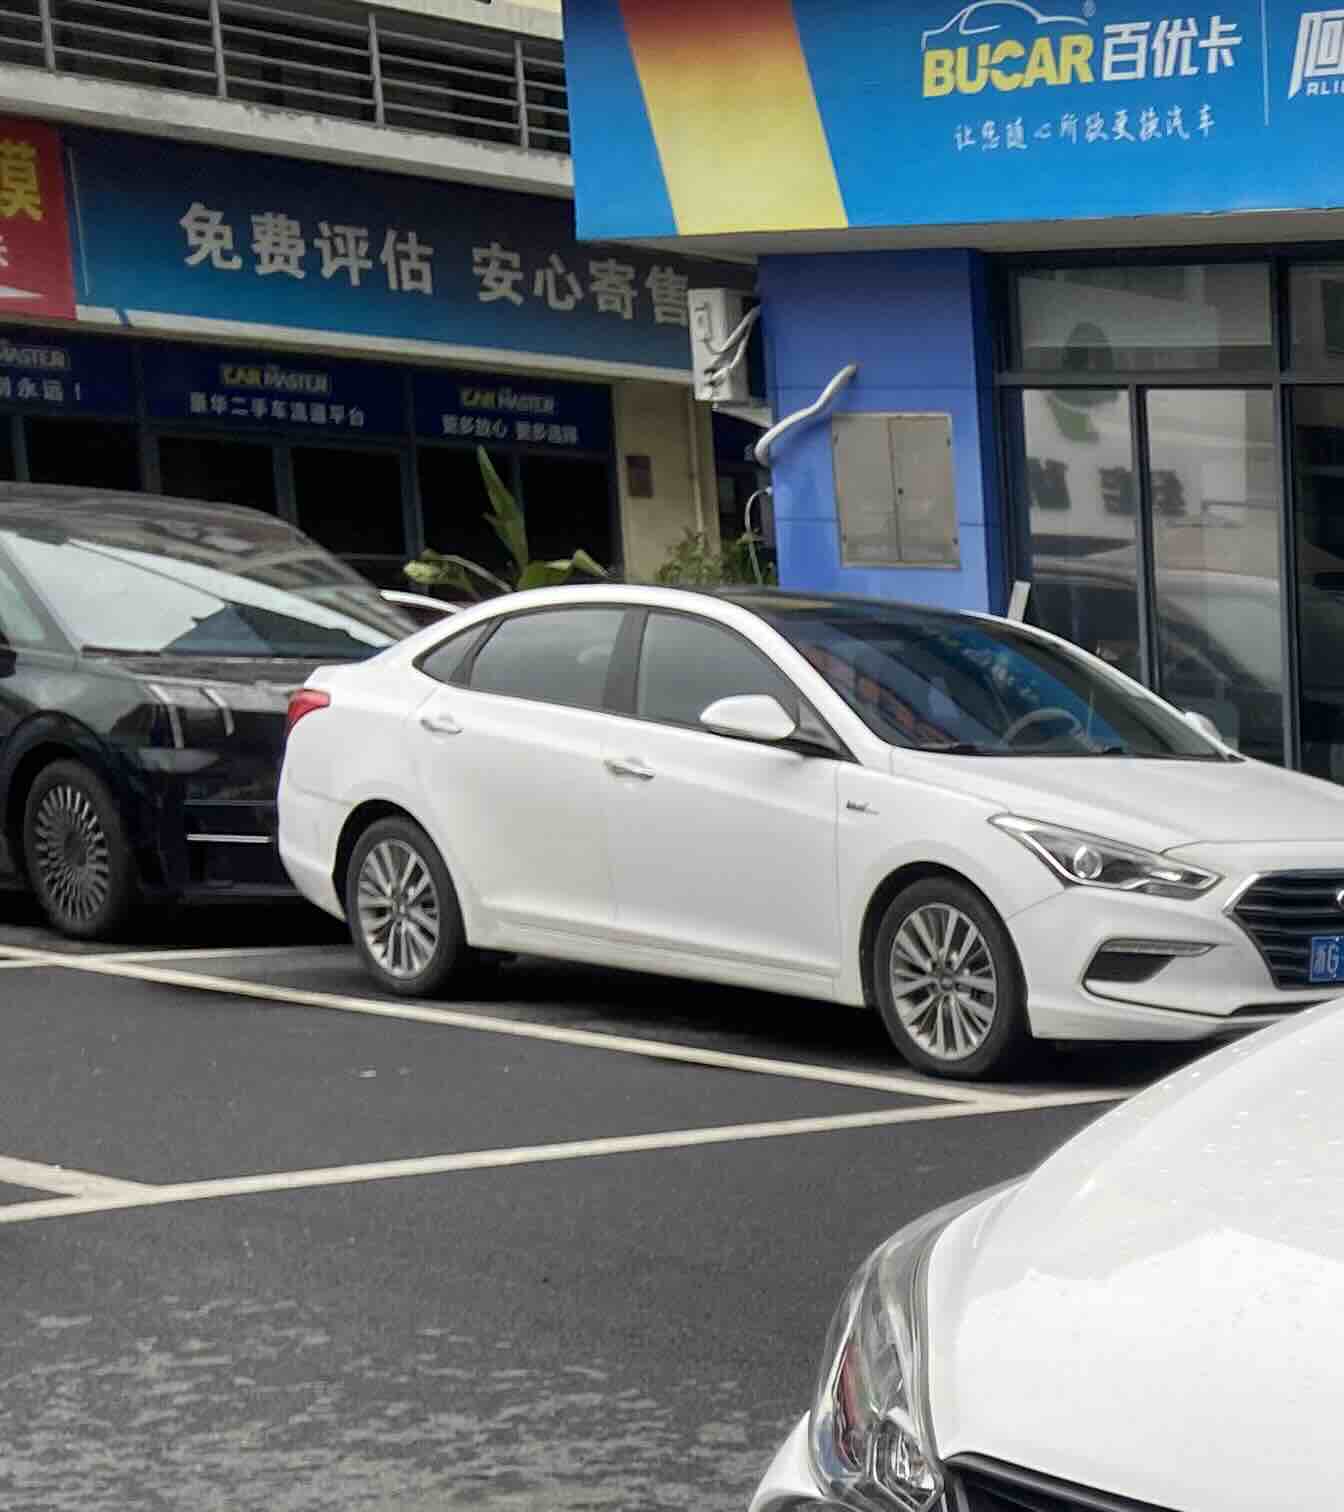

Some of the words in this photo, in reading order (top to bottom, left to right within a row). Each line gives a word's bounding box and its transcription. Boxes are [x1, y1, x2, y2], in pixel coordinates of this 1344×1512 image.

[922, 35, 1095, 97] BUCAR
[1101, 17, 1242, 82] 百优卡
[179, 201, 435, 295] 免费评估
[471, 240, 690, 327] 安心寄售
